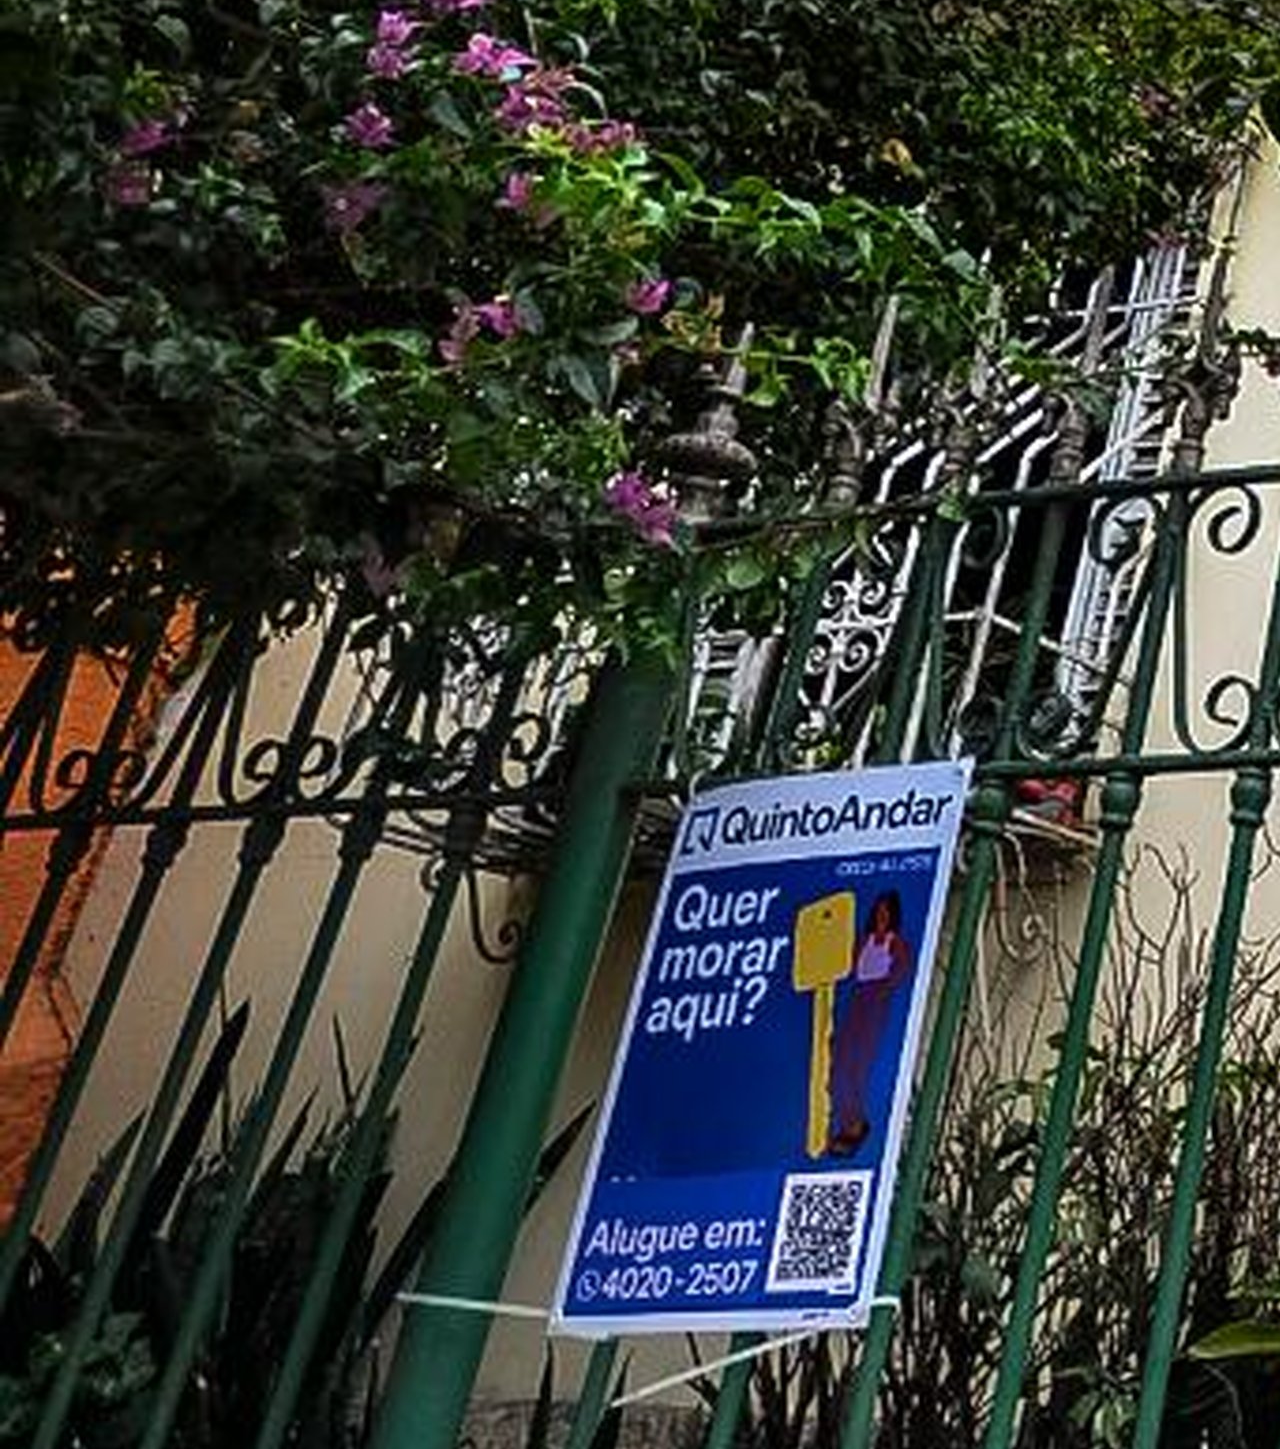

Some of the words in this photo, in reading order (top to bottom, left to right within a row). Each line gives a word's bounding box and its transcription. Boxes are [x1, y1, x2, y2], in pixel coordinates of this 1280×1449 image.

[721, 789, 953, 845] QuintoAndar
[673, 883, 781, 931] Quer
[658, 936, 790, 983] morar
[645, 975, 768, 1043] aqui?
[583, 1217, 699, 1263] Alugue
[704, 1217, 767, 1250] em:
